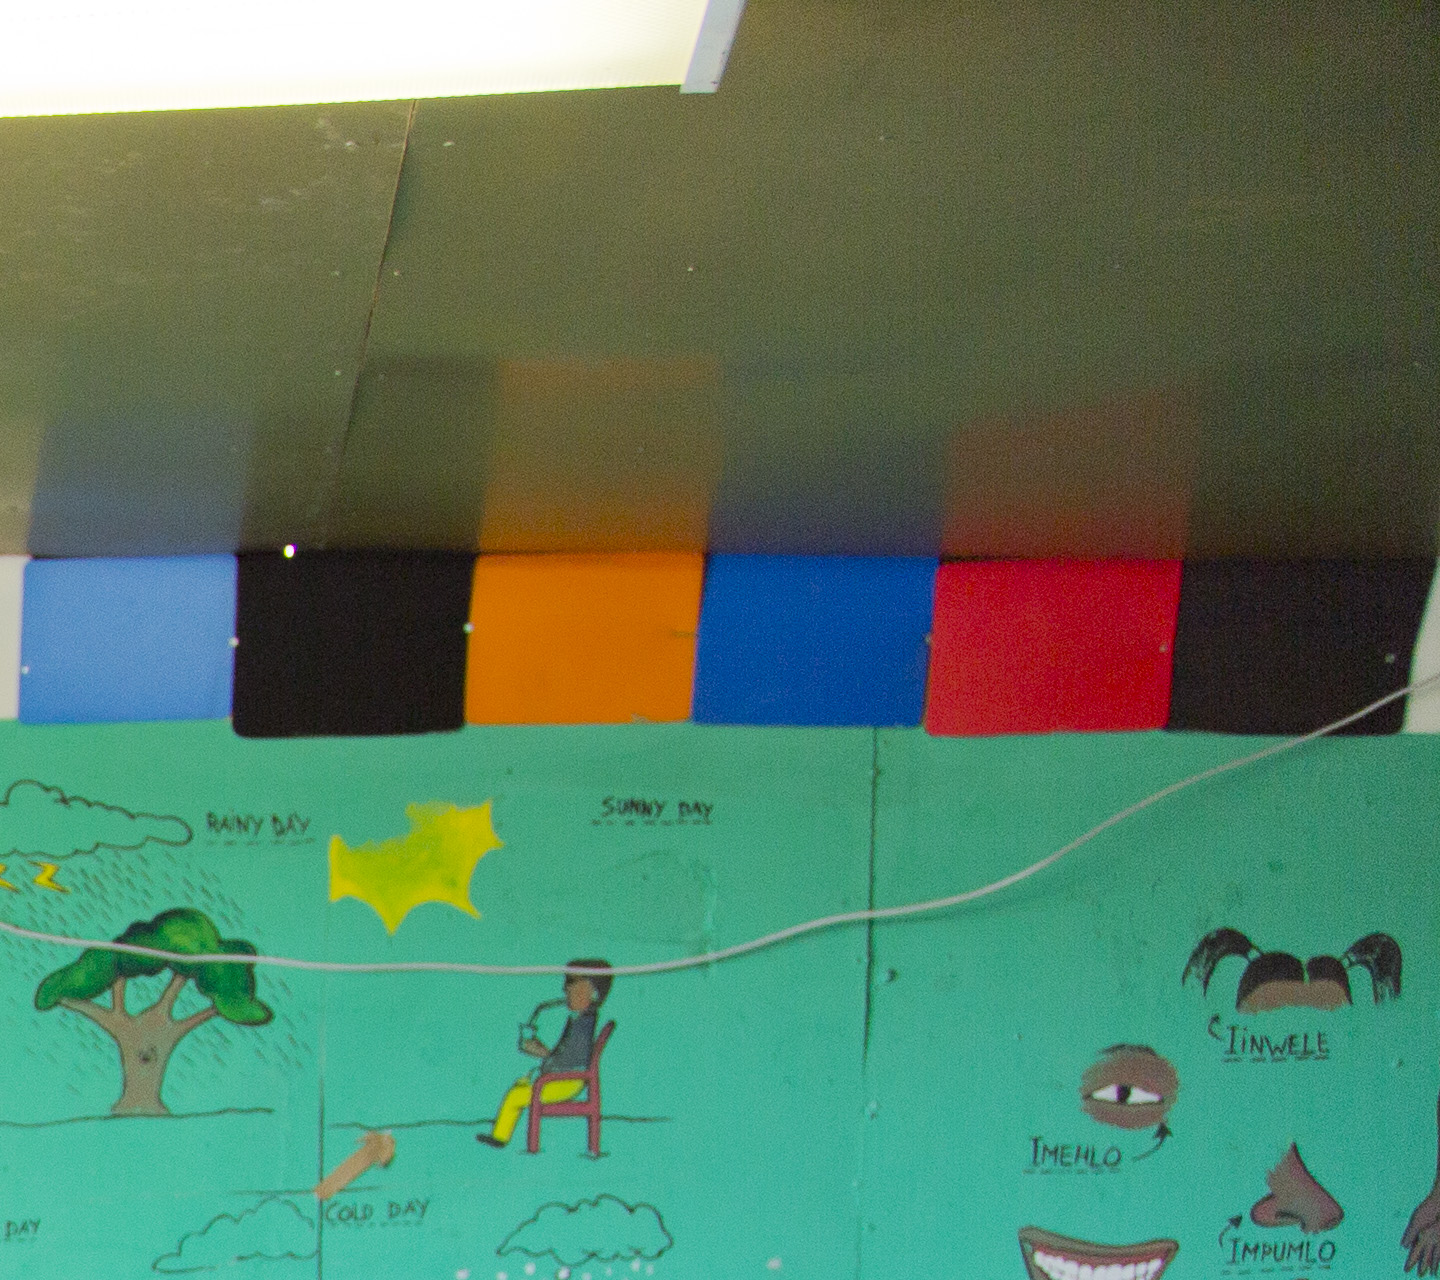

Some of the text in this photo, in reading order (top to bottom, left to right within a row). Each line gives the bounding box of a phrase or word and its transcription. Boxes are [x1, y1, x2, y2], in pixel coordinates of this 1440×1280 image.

[678, 801, 714, 821] DAY
[271, 812, 311, 837] DAY
[325, 1199, 429, 1223] COLD DAY
[3, 1218, 41, 1241] DAY
[1229, 1237, 1336, 1264] IMPUMLO
